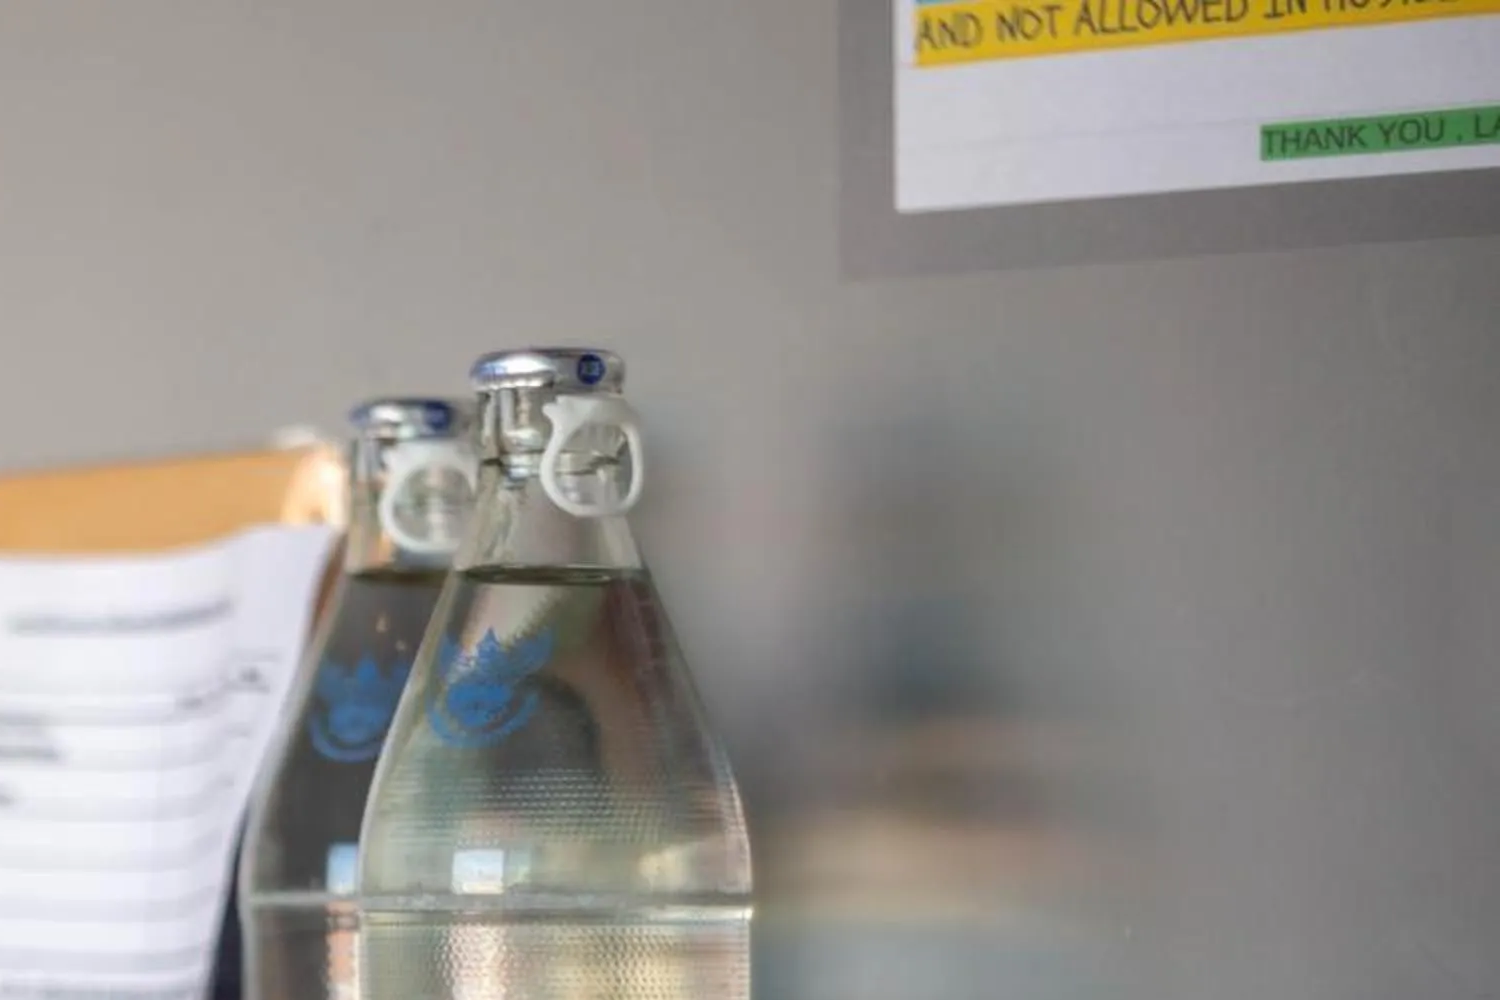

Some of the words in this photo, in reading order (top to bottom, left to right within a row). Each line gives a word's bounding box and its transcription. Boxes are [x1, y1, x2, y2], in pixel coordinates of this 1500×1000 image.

[915, 13, 983, 49] AND
[996, 5, 1063, 41] NOT
[1073, 0, 1248, 35] ALLOWED
[1263, 125, 1367, 154] THANK
[1377, 118, 1445, 145] YOU
